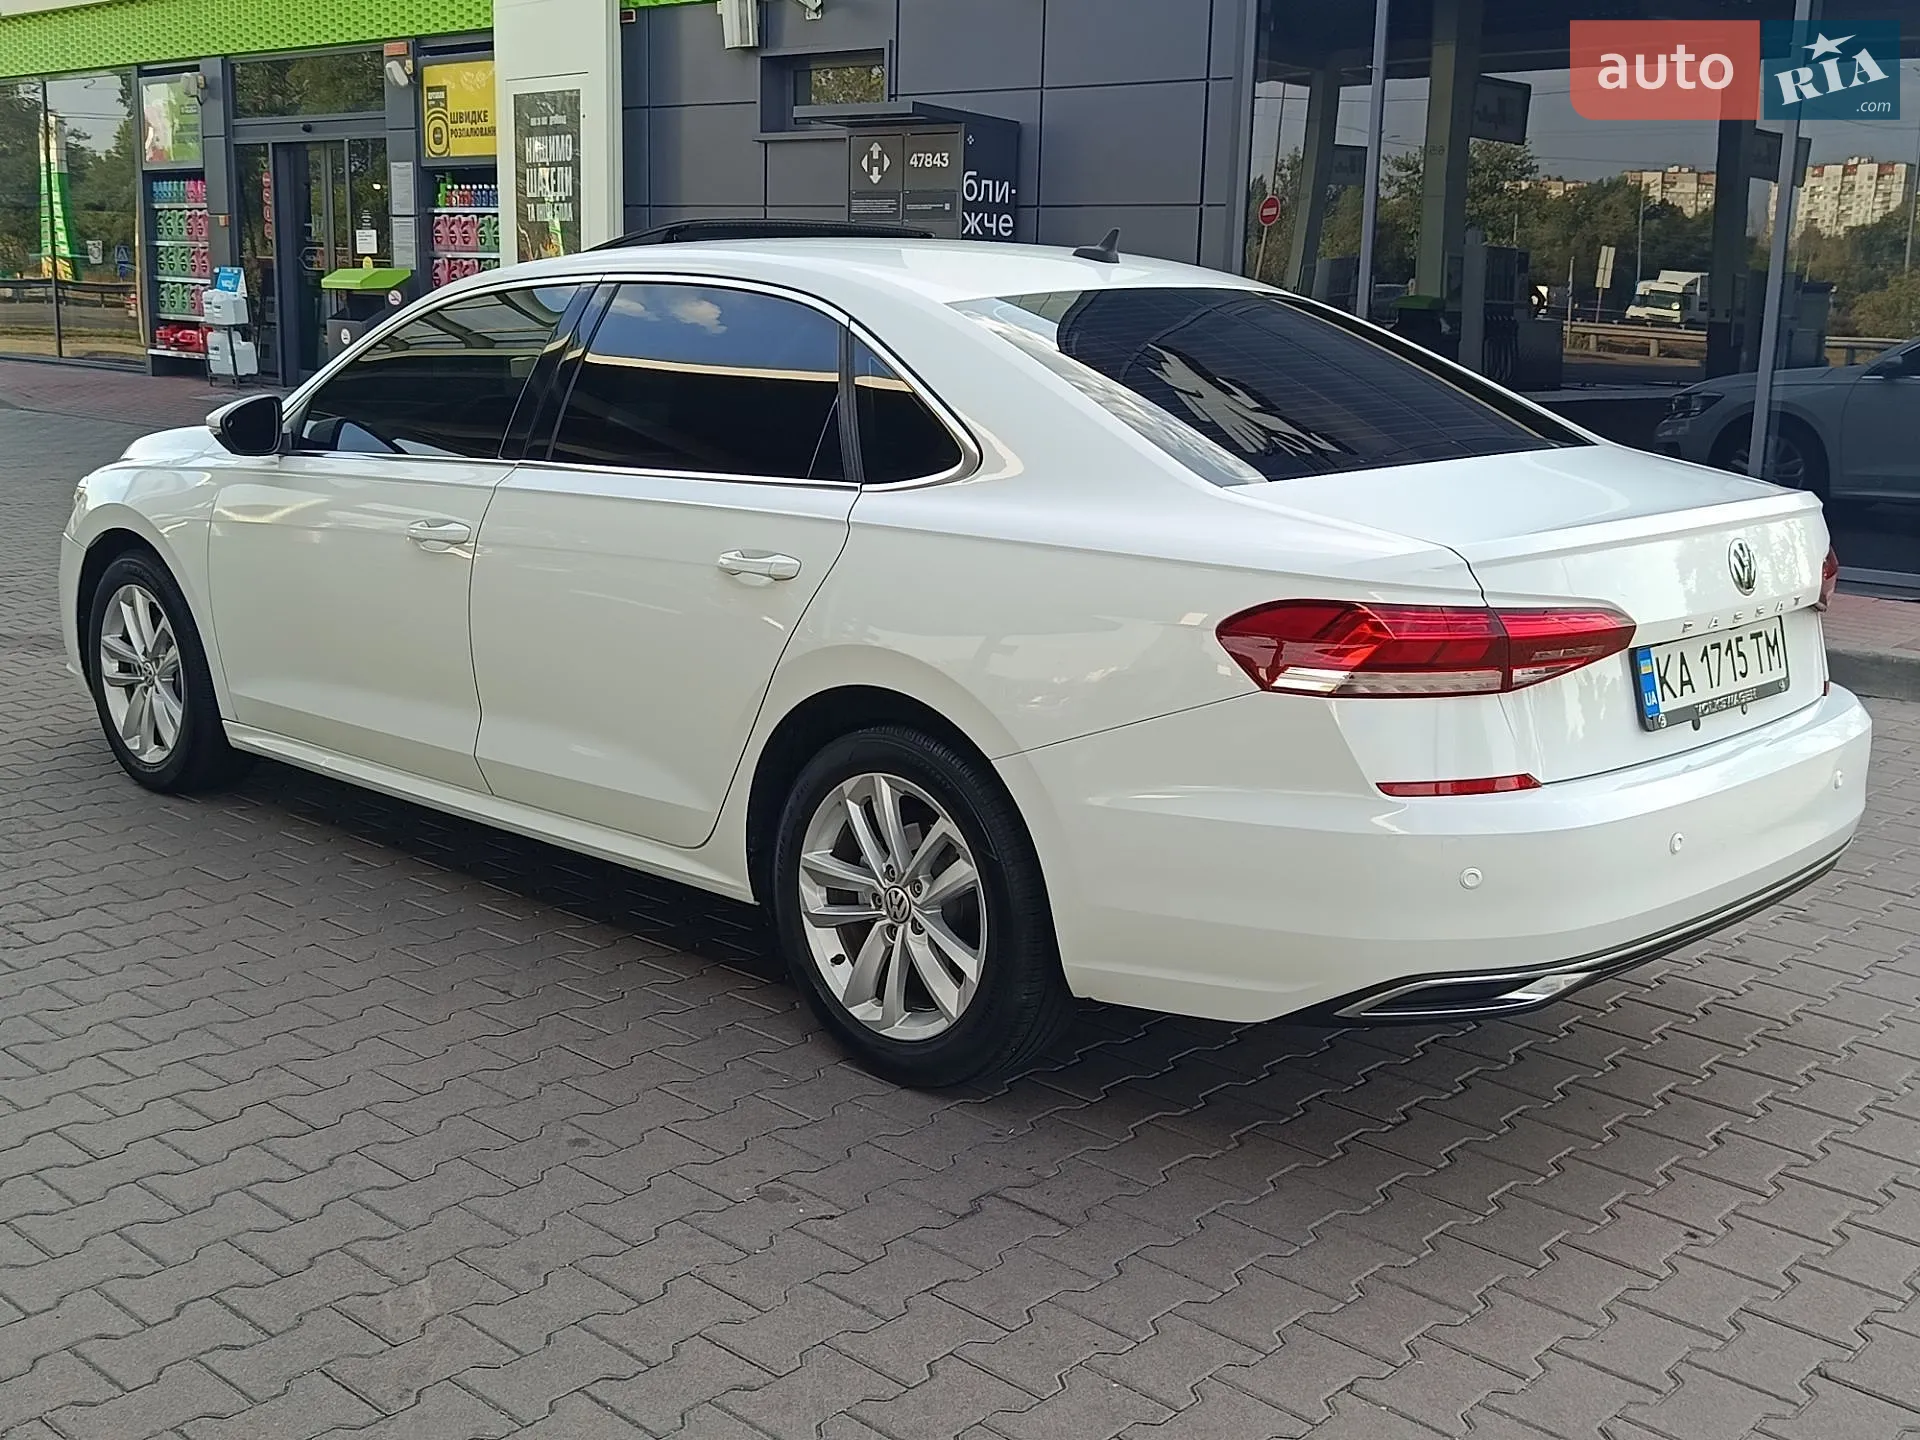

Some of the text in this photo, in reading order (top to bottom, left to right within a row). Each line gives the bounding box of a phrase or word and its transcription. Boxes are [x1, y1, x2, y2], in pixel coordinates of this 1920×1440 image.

[450, 110, 489, 125] ШВИДКЕ
[909, 152, 950, 168] 47843
[962, 211, 1014, 237] жче
[1655, 628, 1783, 702] KA 1715 TM
[1644, 692, 1658, 707] UA
